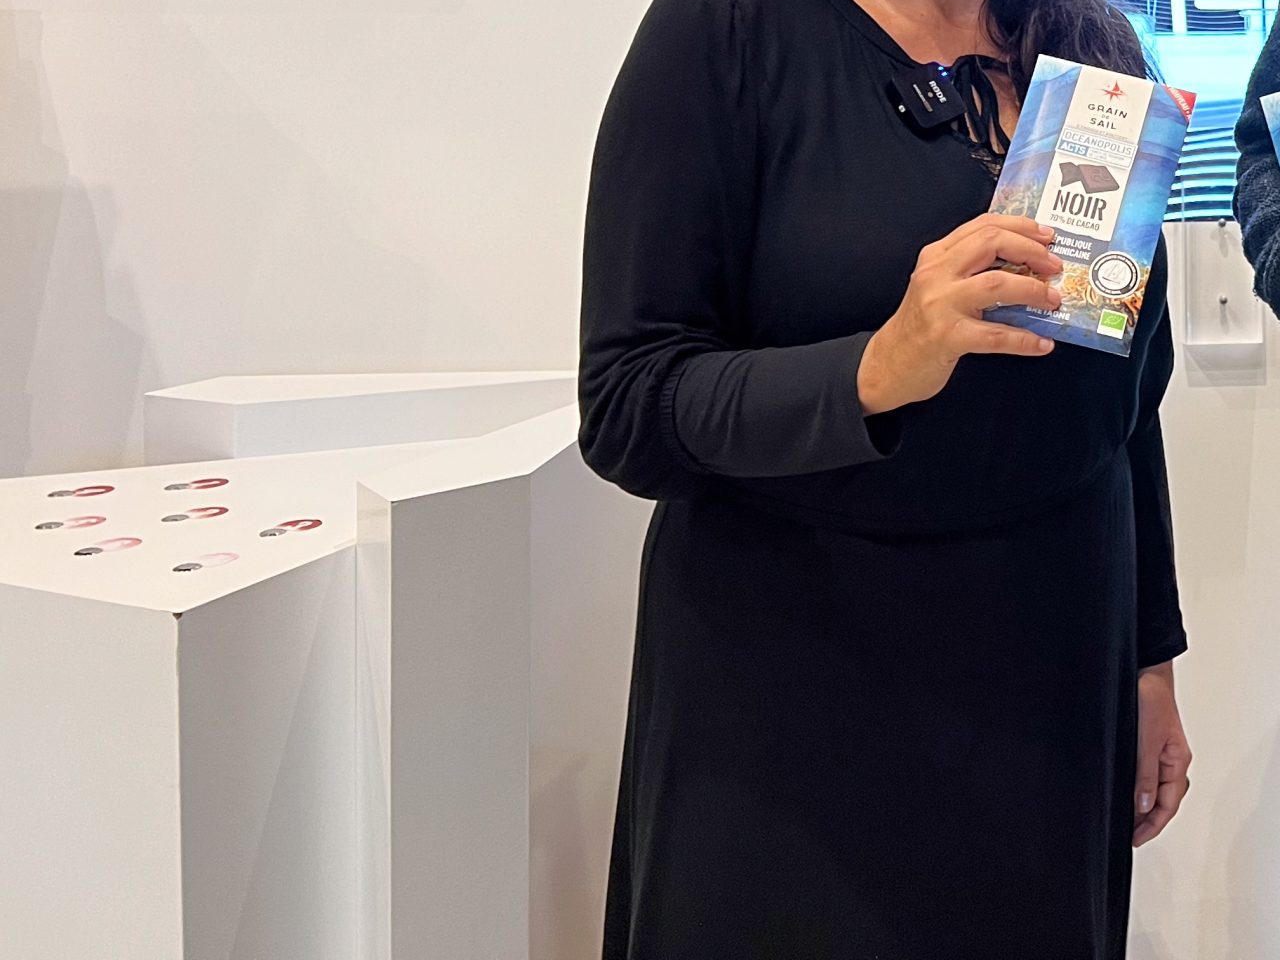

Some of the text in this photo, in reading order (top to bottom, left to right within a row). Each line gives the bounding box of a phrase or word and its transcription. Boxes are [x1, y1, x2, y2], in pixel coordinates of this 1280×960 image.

[1087, 103, 1128, 119] GRAIN
[1089, 117, 1117, 130] SAIL
[1060, 141, 1087, 155] ACTS
[1064, 131, 1132, 156] OCEANOPOLIS
[1052, 189, 1107, 221] NOIR
[1050, 213, 1100, 231] 70% DE CACAO
[1053, 233, 1093, 251] PUBLIQUE
